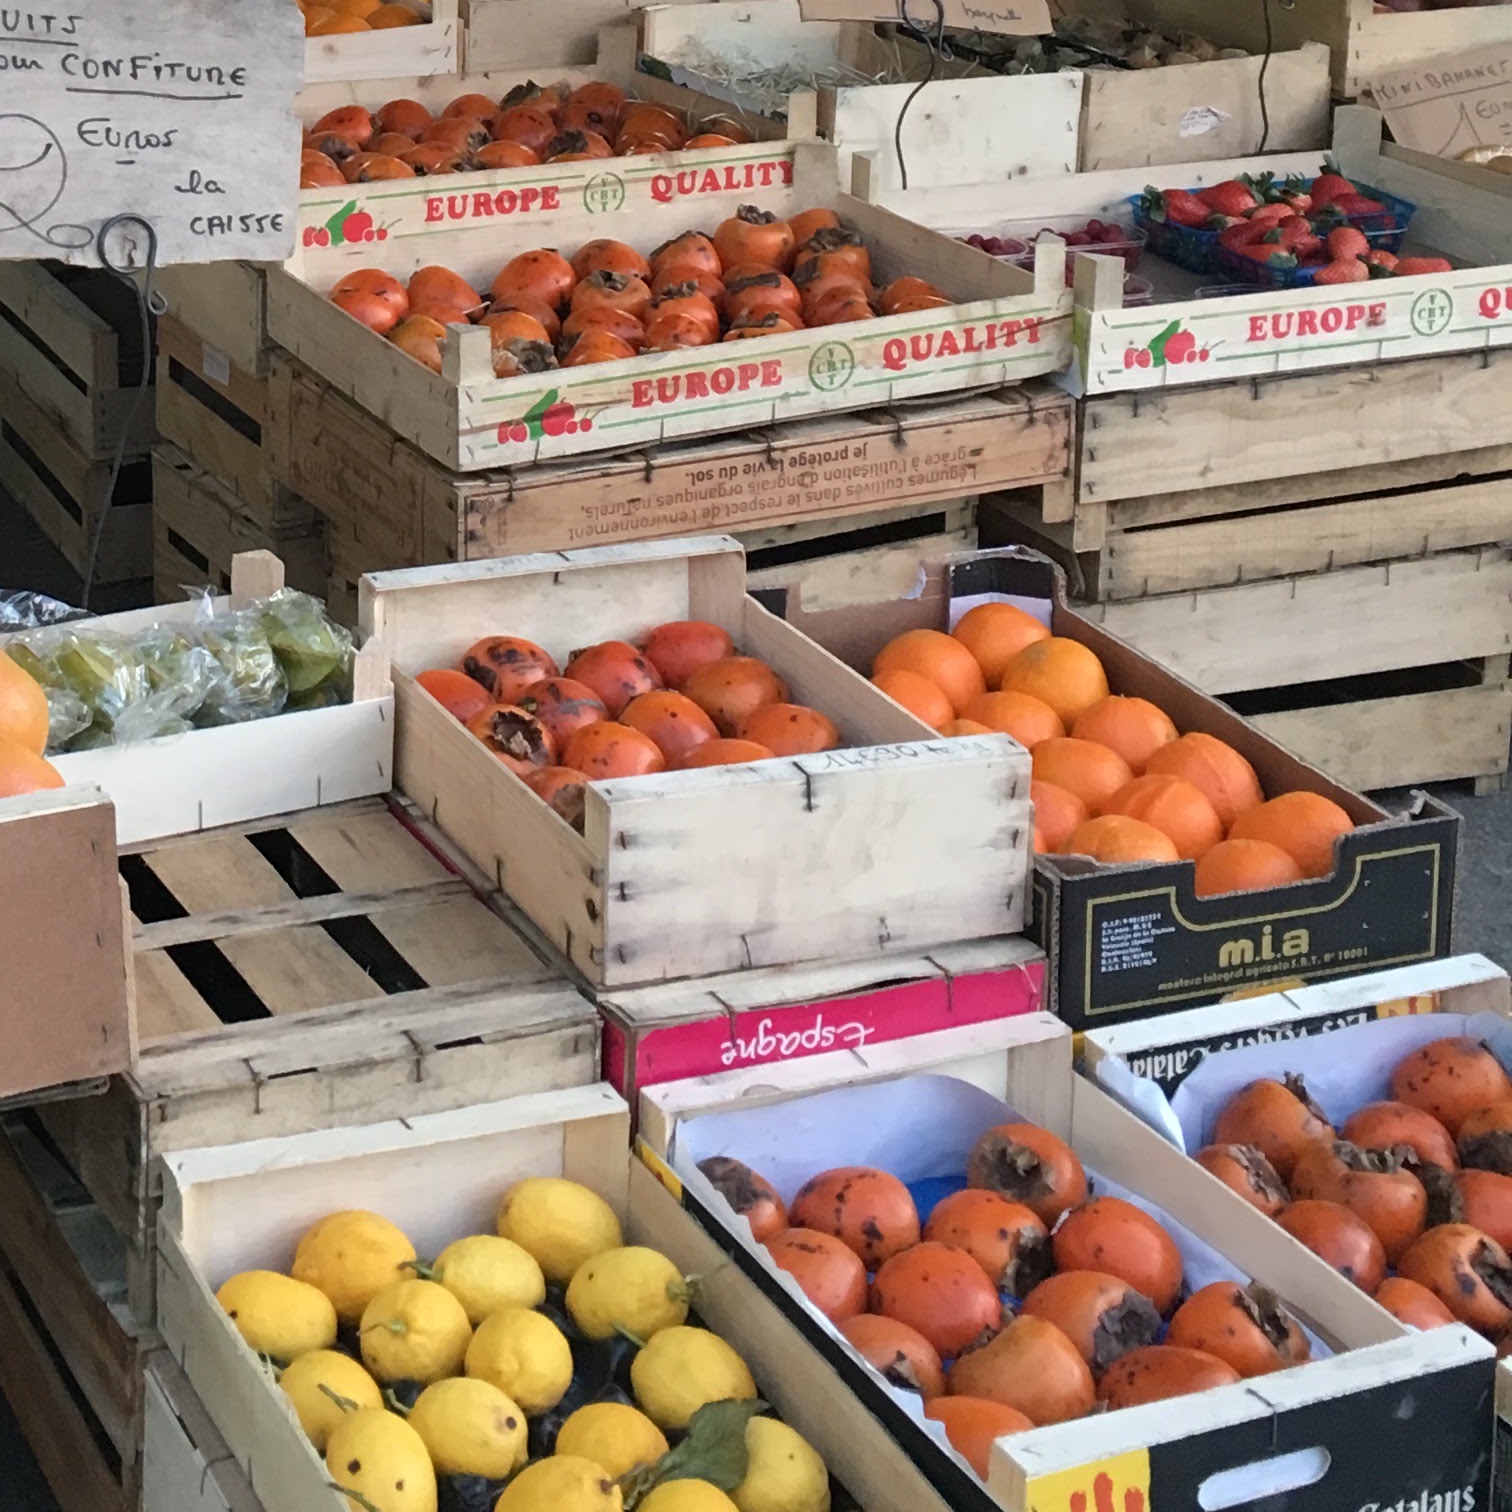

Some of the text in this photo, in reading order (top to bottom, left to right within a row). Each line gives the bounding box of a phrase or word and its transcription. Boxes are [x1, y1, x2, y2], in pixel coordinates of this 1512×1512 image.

[1375, 58, 1509, 101] MINI BANANES
[76, 117, 180, 151] Euros
[424, 161, 794, 223] EUROPE QUALITY
[189, 212, 284, 237] CAISSE
[1246, 301, 1388, 343] EUROPE
[631, 315, 1045, 409] EUROPE QUALITY
[685, 442, 868, 486] je protège la vie du sol.
[910, 455, 921, 473] à
[923, 444, 968, 469] grâce
[567, 462, 978, 542] Légumes cultivés dans le respect de l'environnement
[656, 480, 744, 510] organiques
[719, 1013, 876, 1067] Espagne
